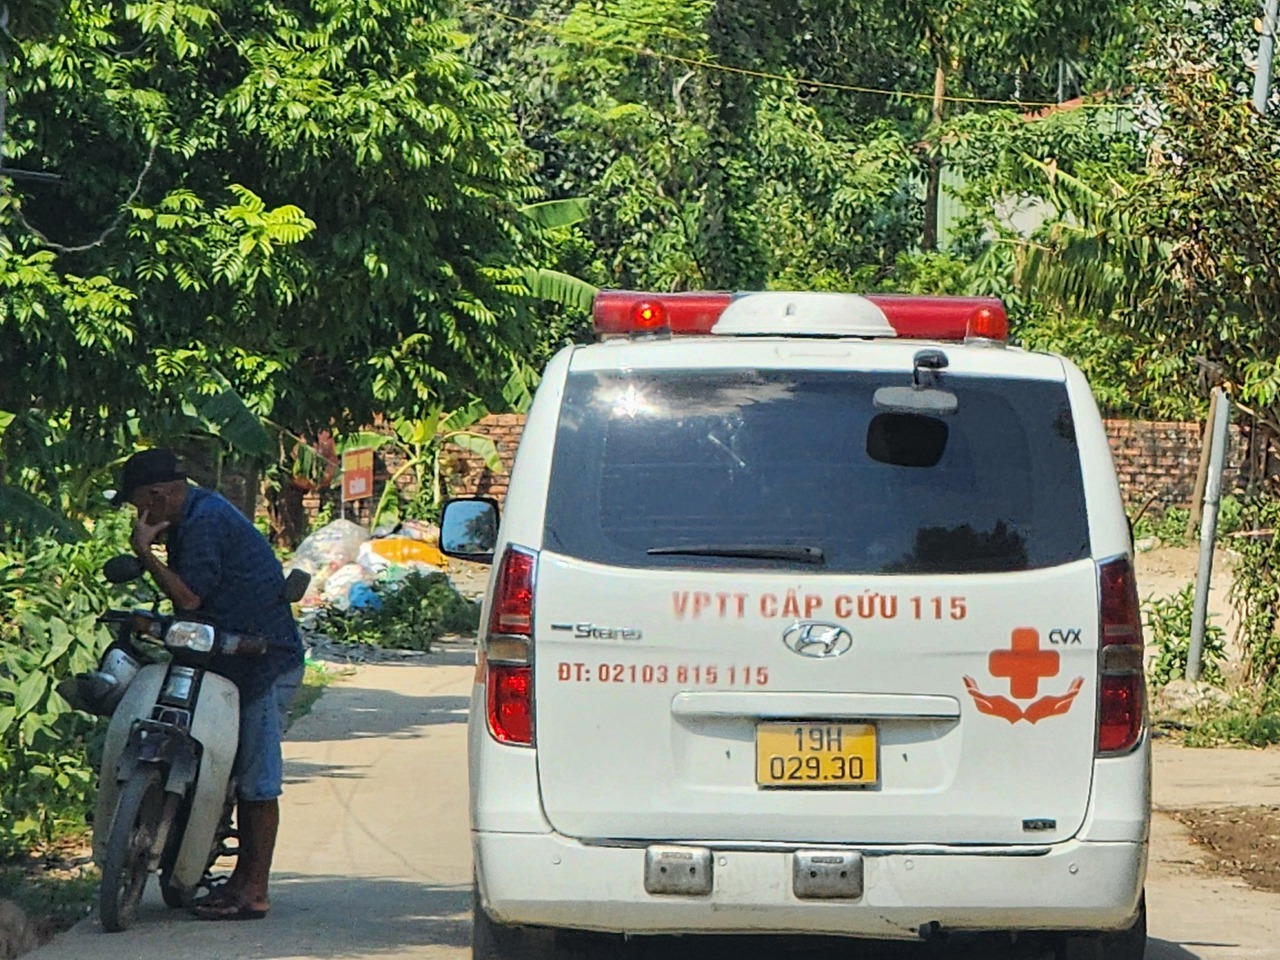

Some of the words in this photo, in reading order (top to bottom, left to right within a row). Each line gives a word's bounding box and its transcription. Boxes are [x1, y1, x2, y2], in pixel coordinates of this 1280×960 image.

[672, 591, 748, 619] VPTT
[759, 585, 823, 619] CẤP
[834, 589, 897, 619] CỨU
[910, 595, 967, 620] 115
[1048, 628, 1082, 645] CVX
[557, 662, 591, 682] ĐT:
[598, 663, 669, 684] 02103
[676, 665, 718, 685] 815
[727, 666, 769, 685] 115
[794, 727, 843, 752] 19H
[769, 755, 864, 780] 029.30
